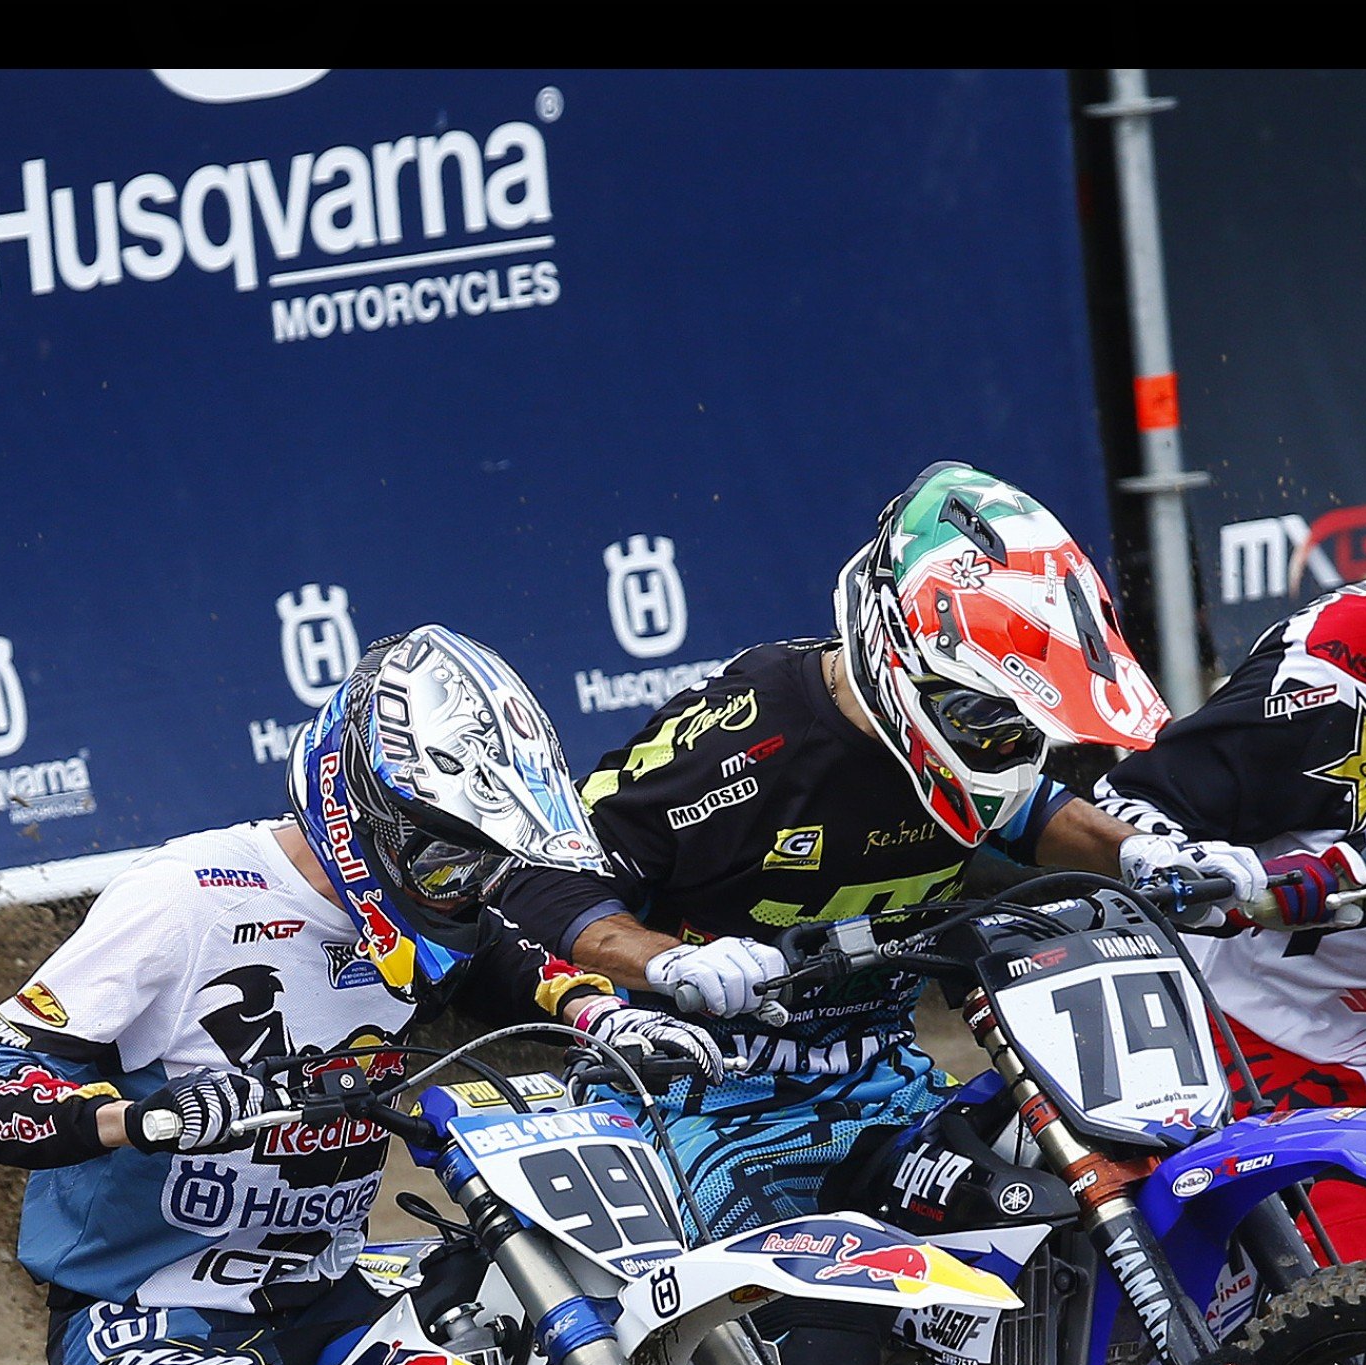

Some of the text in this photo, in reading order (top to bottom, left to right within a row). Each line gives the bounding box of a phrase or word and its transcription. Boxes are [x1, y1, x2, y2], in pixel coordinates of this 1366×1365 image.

[272, 260, 561, 345] MOTORCYCLES
[1003, 656, 1059, 706] OGIO
[1266, 686, 1338, 718] MXGP
[721, 734, 786, 778] MXGP
[320, 753, 370, 885] Red Bull
[671, 780, 756, 828] MOTOSED
[195, 867, 266, 885] PARTS
[232, 919, 306, 945] MXGP
[1091, 933, 1164, 959] YAMAHA
[1007, 945, 1070, 979] MXGP
[817, 1001, 884, 1018] YOURSELF
[1049, 969, 1209, 1112] 19
[909, 1200, 945, 1223] RACING
[761, 1231, 836, 1255] Red Bull
